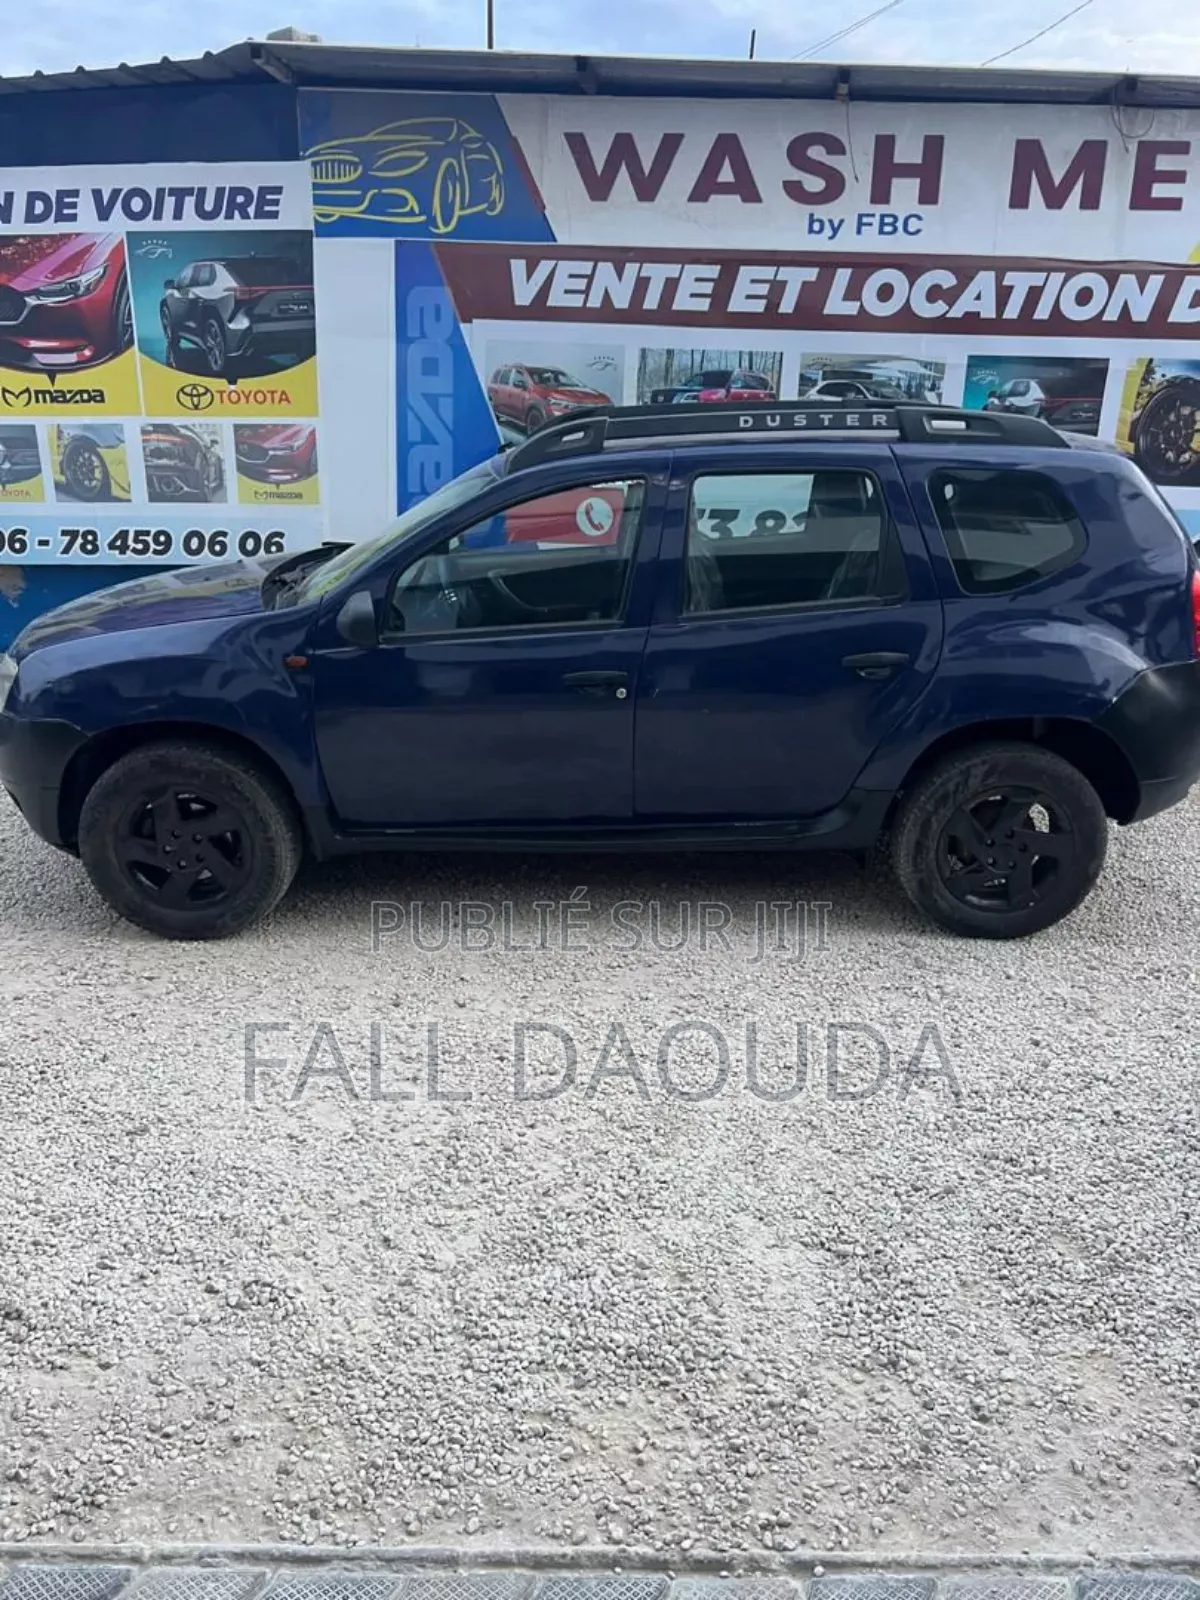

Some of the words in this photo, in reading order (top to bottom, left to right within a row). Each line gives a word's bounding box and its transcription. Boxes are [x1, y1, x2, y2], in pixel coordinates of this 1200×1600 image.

[563, 131, 945, 206] WASH
[1009, 139, 1191, 211] ME
[24, 189, 80, 224] DE
[91, 186, 284, 222] VOITURE
[807, 213, 845, 240] by
[855, 213, 924, 236] FBC
[509, 259, 721, 312] VENTE
[727, 265, 820, 314] ET
[823, 267, 1166, 322] LOCATION
[34, 388, 105, 404] mazda
[216, 390, 292, 405] TOYOTA
[407, 286, 454, 505] azda
[739, 414, 889, 428] DUSTER
[0, 528, 28, 555] 6
[60, 529, 98, 556] 78
[107, 529, 173, 556] 459
[182, 531, 228, 557] 06
[238, 532, 285, 556] 06
